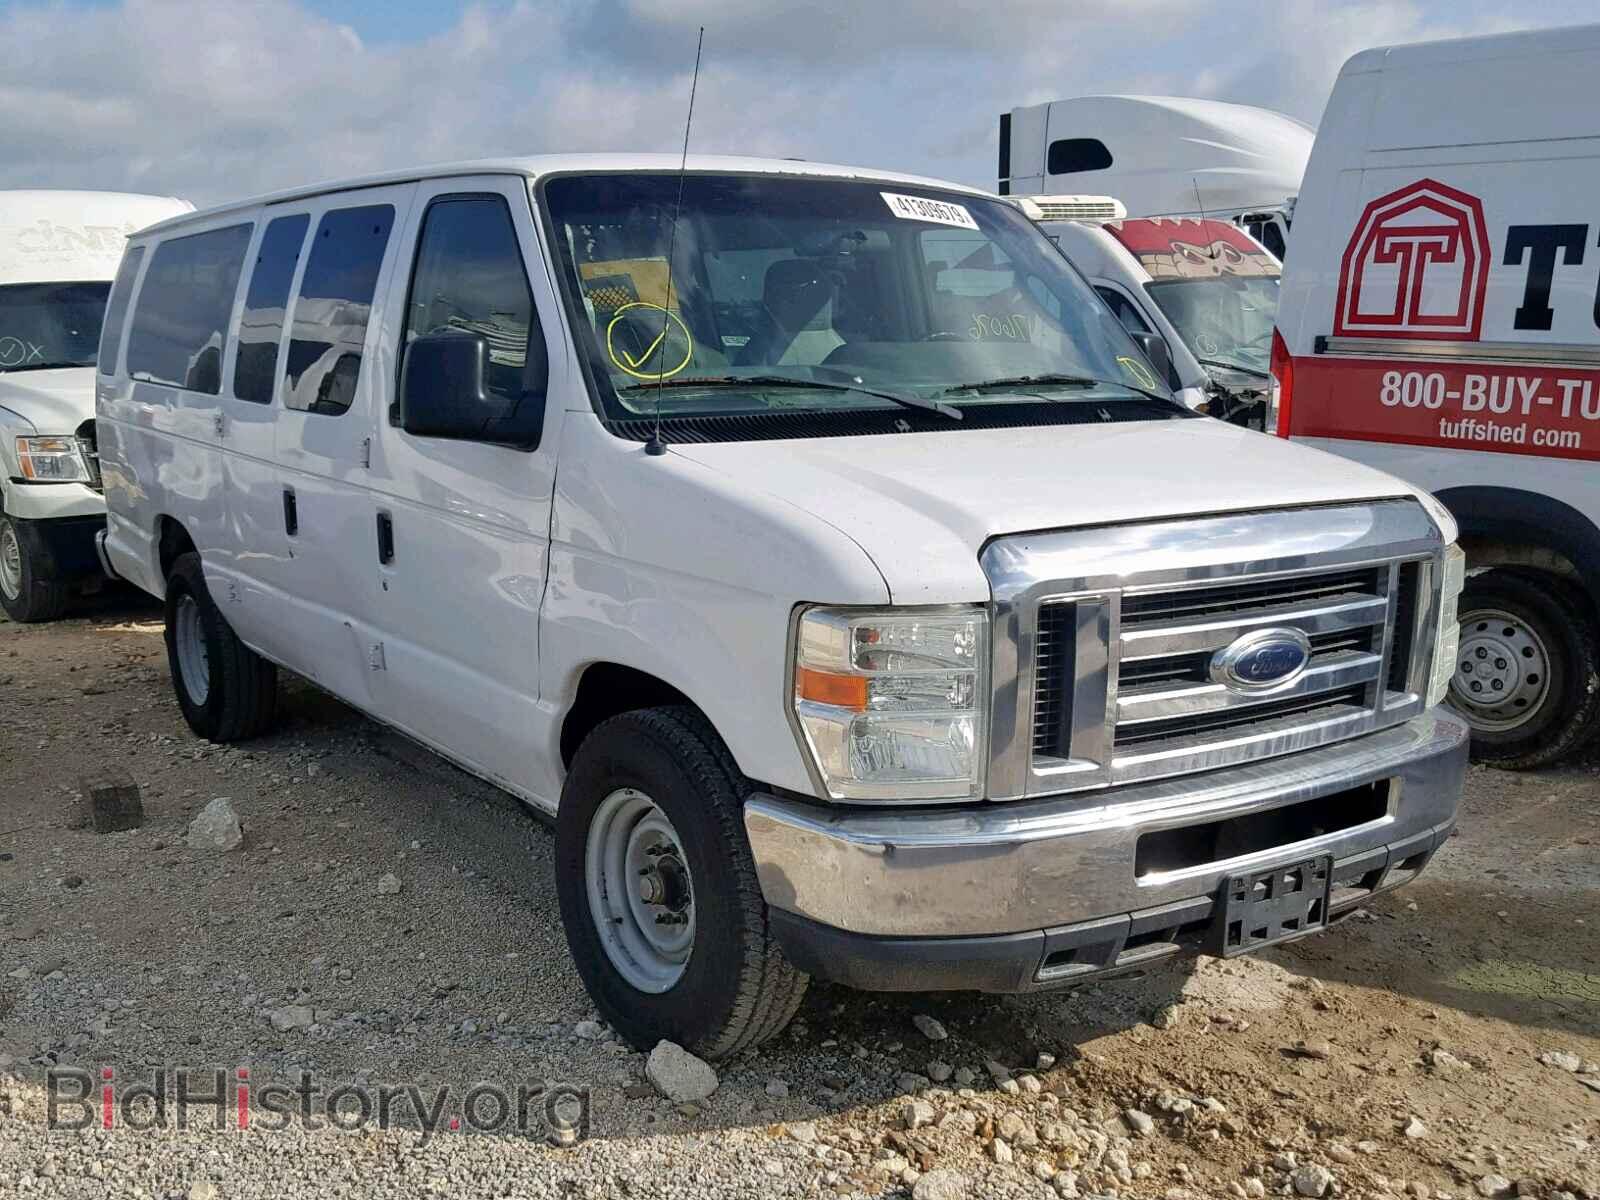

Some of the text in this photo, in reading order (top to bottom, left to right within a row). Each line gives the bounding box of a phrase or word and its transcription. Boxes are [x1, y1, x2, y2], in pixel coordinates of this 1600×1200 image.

[1503, 224, 1600, 331] T
[1380, 371, 1600, 420] 800-BUY-TU
[1439, 418, 1526, 444] tuffshed
